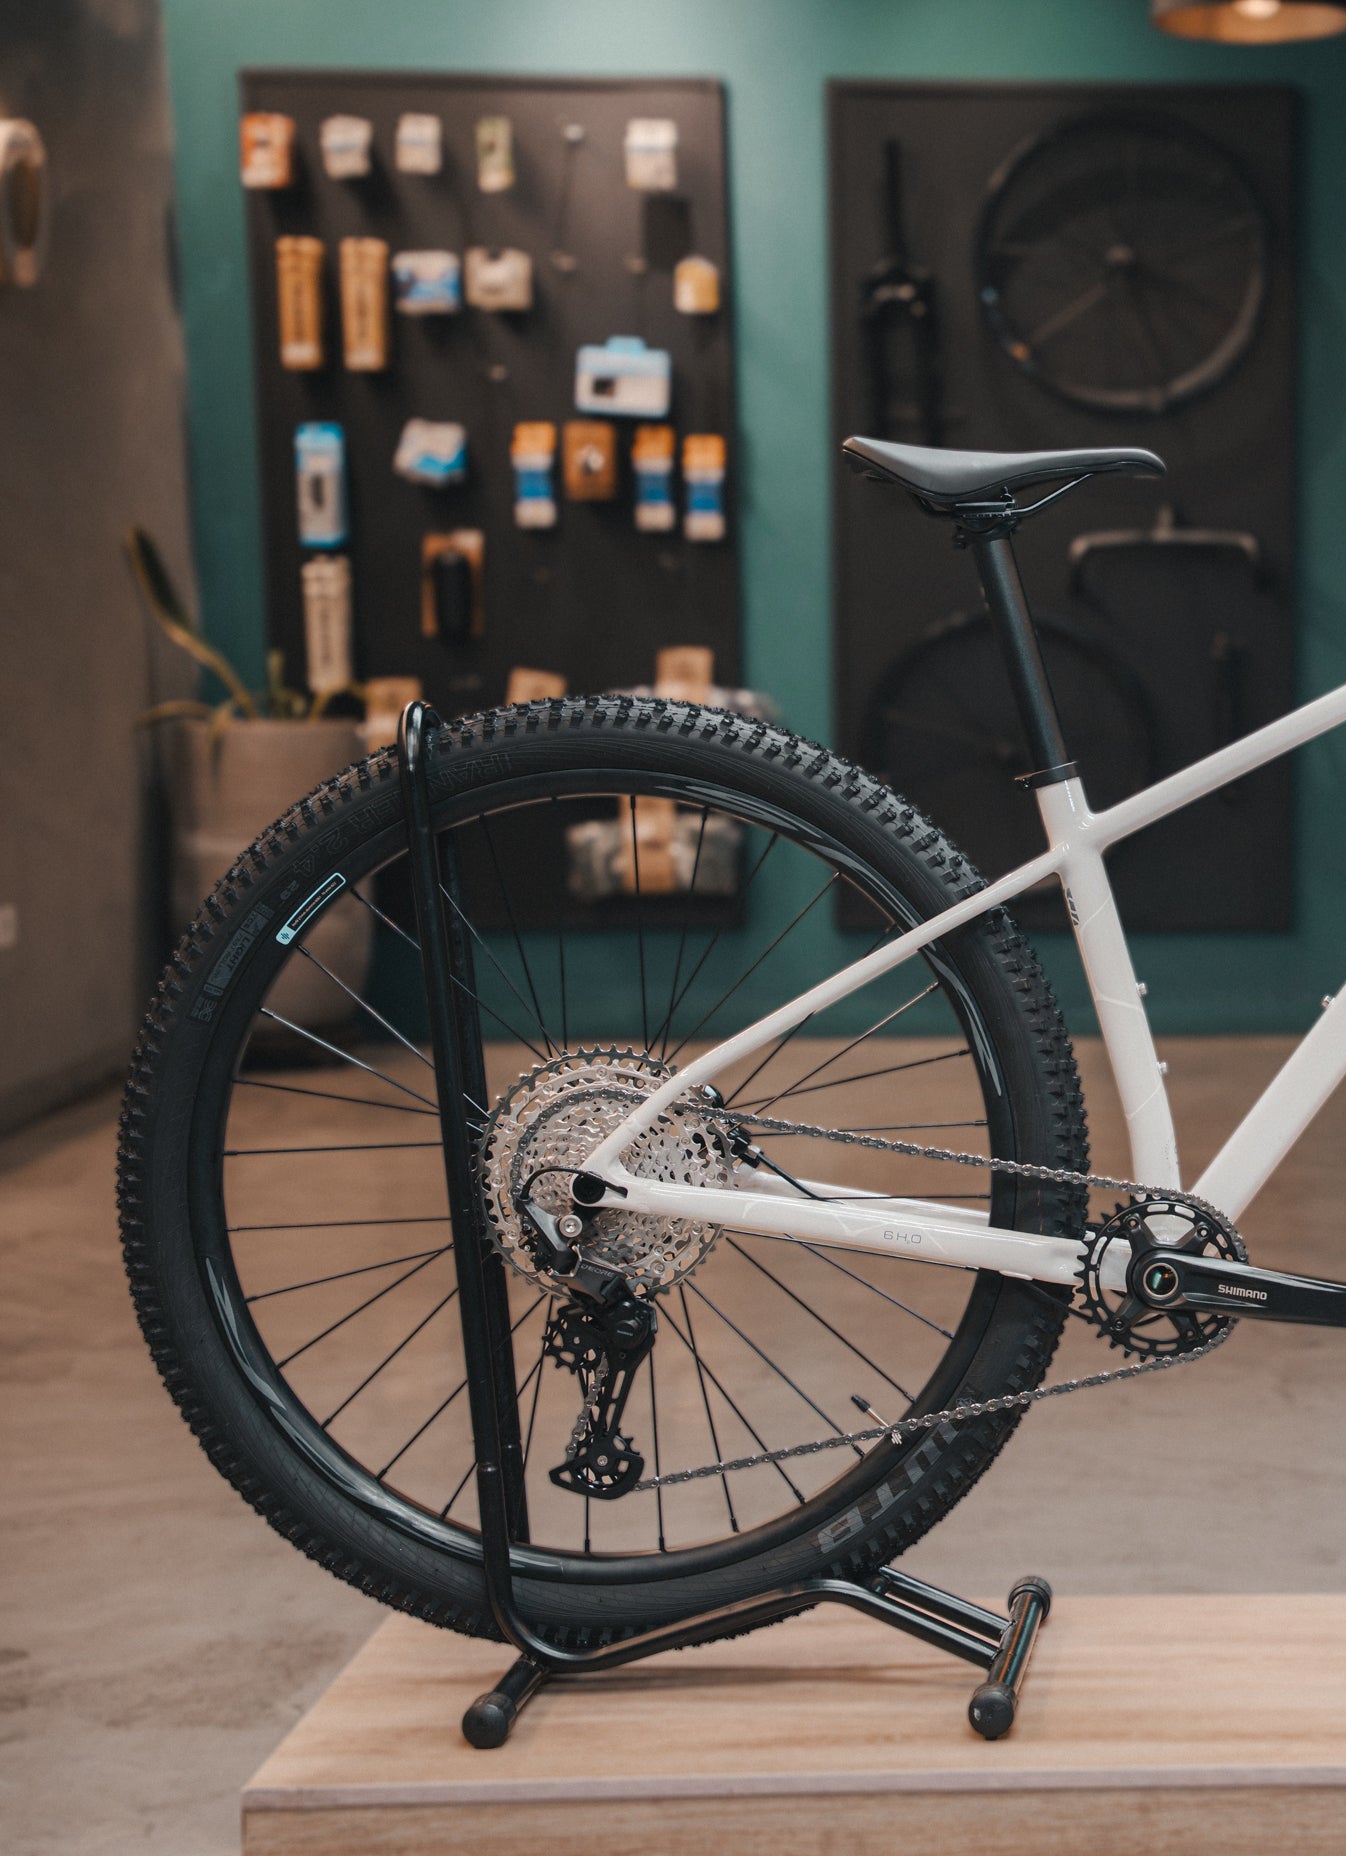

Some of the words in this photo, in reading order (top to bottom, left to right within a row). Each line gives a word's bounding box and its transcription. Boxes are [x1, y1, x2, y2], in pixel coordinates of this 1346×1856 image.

[349, 752, 510, 832] RANER
[580, 1263, 615, 1278] DEORE
[1217, 1283, 1268, 1301] SHIMANO
